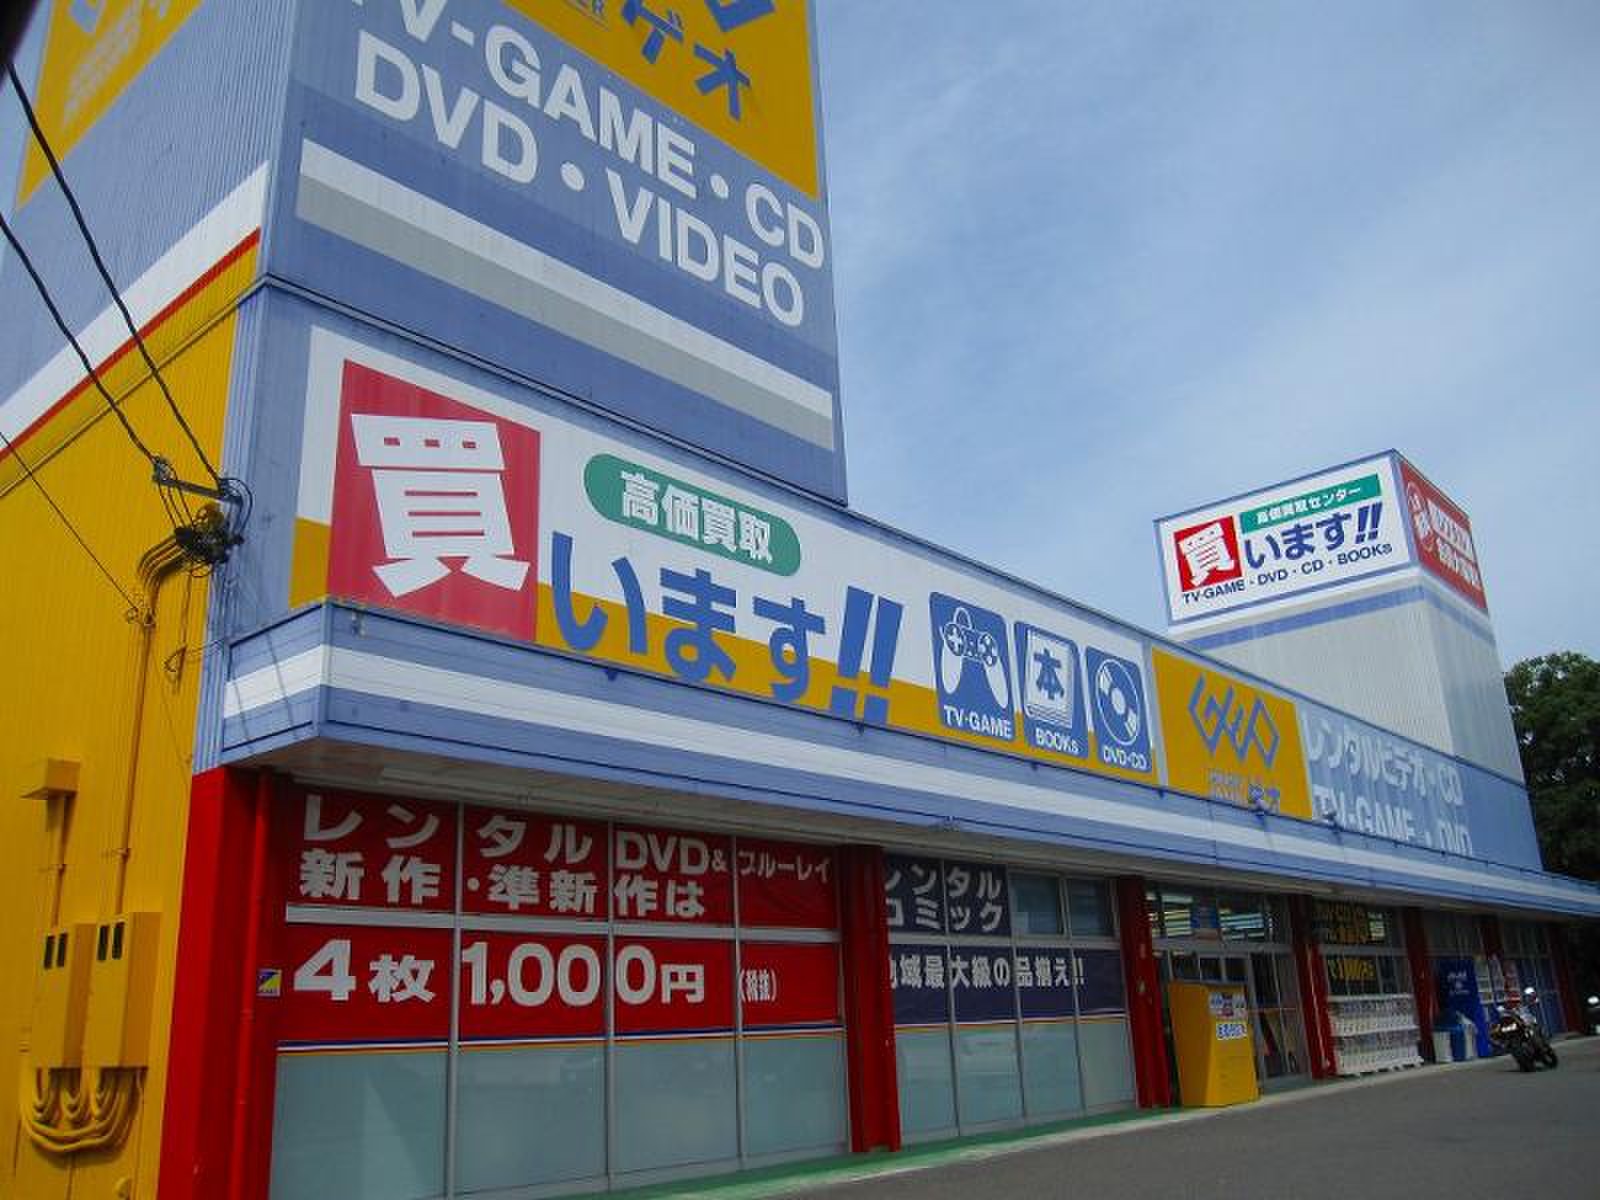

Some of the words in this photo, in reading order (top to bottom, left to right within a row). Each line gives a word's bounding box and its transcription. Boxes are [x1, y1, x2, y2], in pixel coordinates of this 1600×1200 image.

[348, 0, 698, 200] V-GAME
[745, 182, 825, 269] CD
[355, 29, 539, 185] DVD
[605, 166, 804, 328] VIDEO
[620, 470, 773, 565] 高価買取
